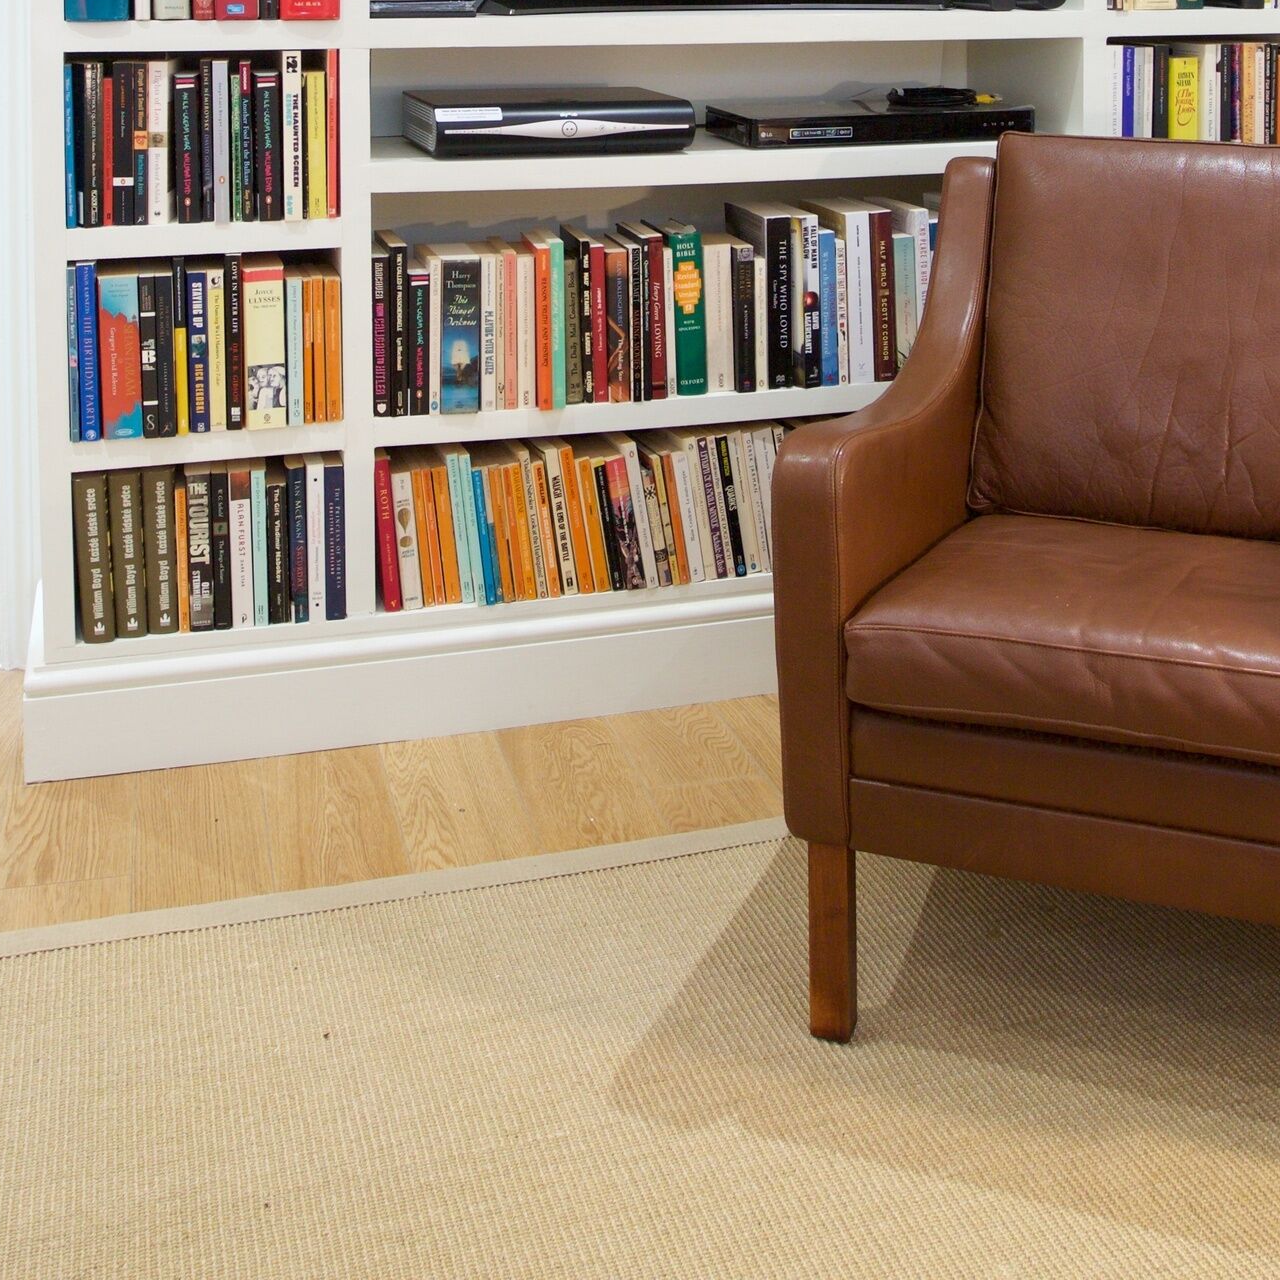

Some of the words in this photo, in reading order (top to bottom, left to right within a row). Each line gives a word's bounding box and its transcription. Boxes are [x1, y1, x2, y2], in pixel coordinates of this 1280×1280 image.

[779, 240, 787, 262] THE
[232, 283, 237, 291] IN
[779, 264, 787, 282] SPY
[191, 282, 202, 315] STAYING
[653, 282, 661, 301] Henry
[779, 285, 787, 311] WHO
[83, 315, 92, 334] THE
[193, 317, 202, 328] UP
[779, 315, 787, 348] LOVED
[654, 323, 662, 358] LOVING
[83, 337, 94, 391] BIRTHDAY
[85, 394, 95, 426] PARTY
[189, 482, 208, 495] THE
[552, 475, 561, 499] WAUGH
[272, 503, 280, 516] Gift
[379, 489, 389, 520] ROTH
[189, 495, 209, 564] TOURIST
[273, 520, 281, 551] Vladimir
[274, 552, 282, 583] Nabokov
[296, 545, 304, 588] SATURDAY
